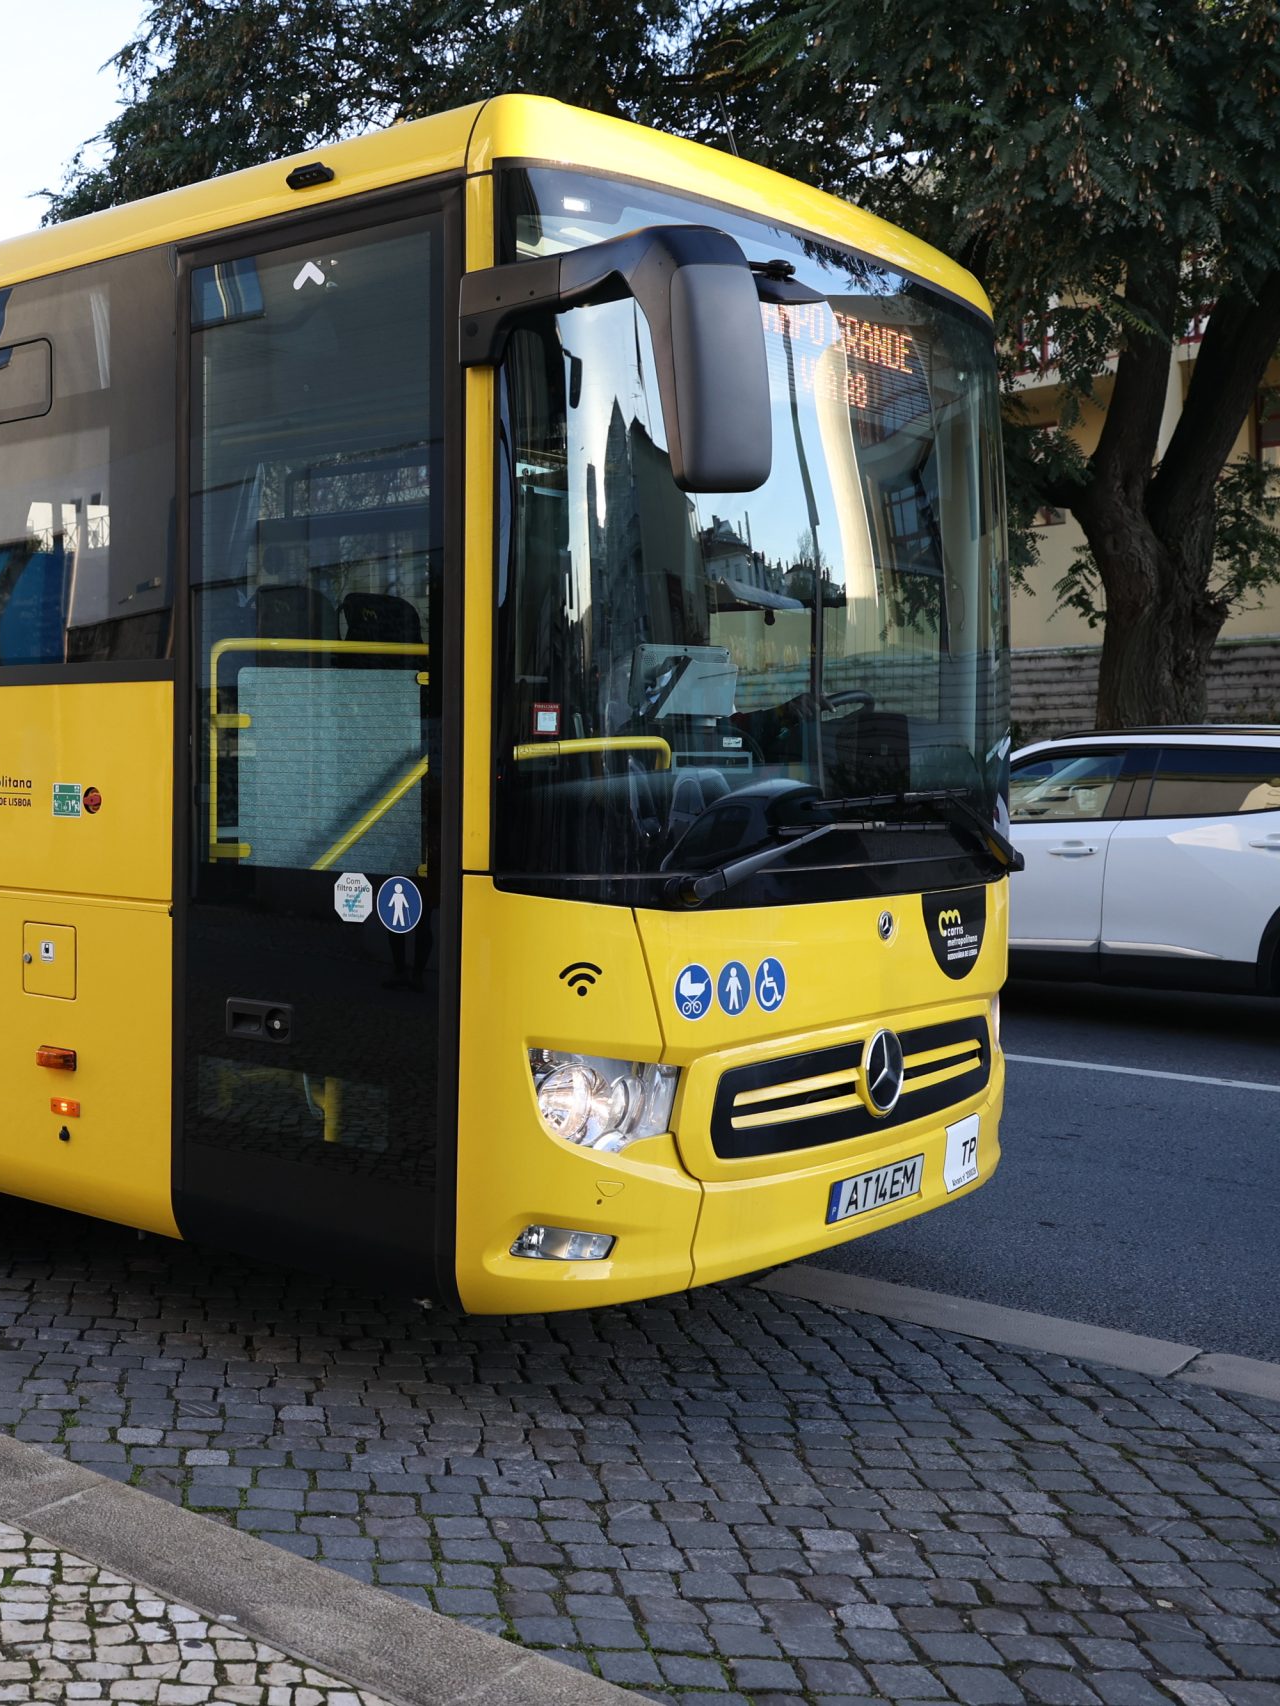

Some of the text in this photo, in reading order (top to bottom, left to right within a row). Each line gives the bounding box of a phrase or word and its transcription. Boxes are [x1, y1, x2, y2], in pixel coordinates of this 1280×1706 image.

[762, 303, 913, 375] AMPO GRANDE
[8, 796, 32, 808] LISBOA
[346, 877, 361, 885] Com
[961, 1136, 977, 1166] TP
